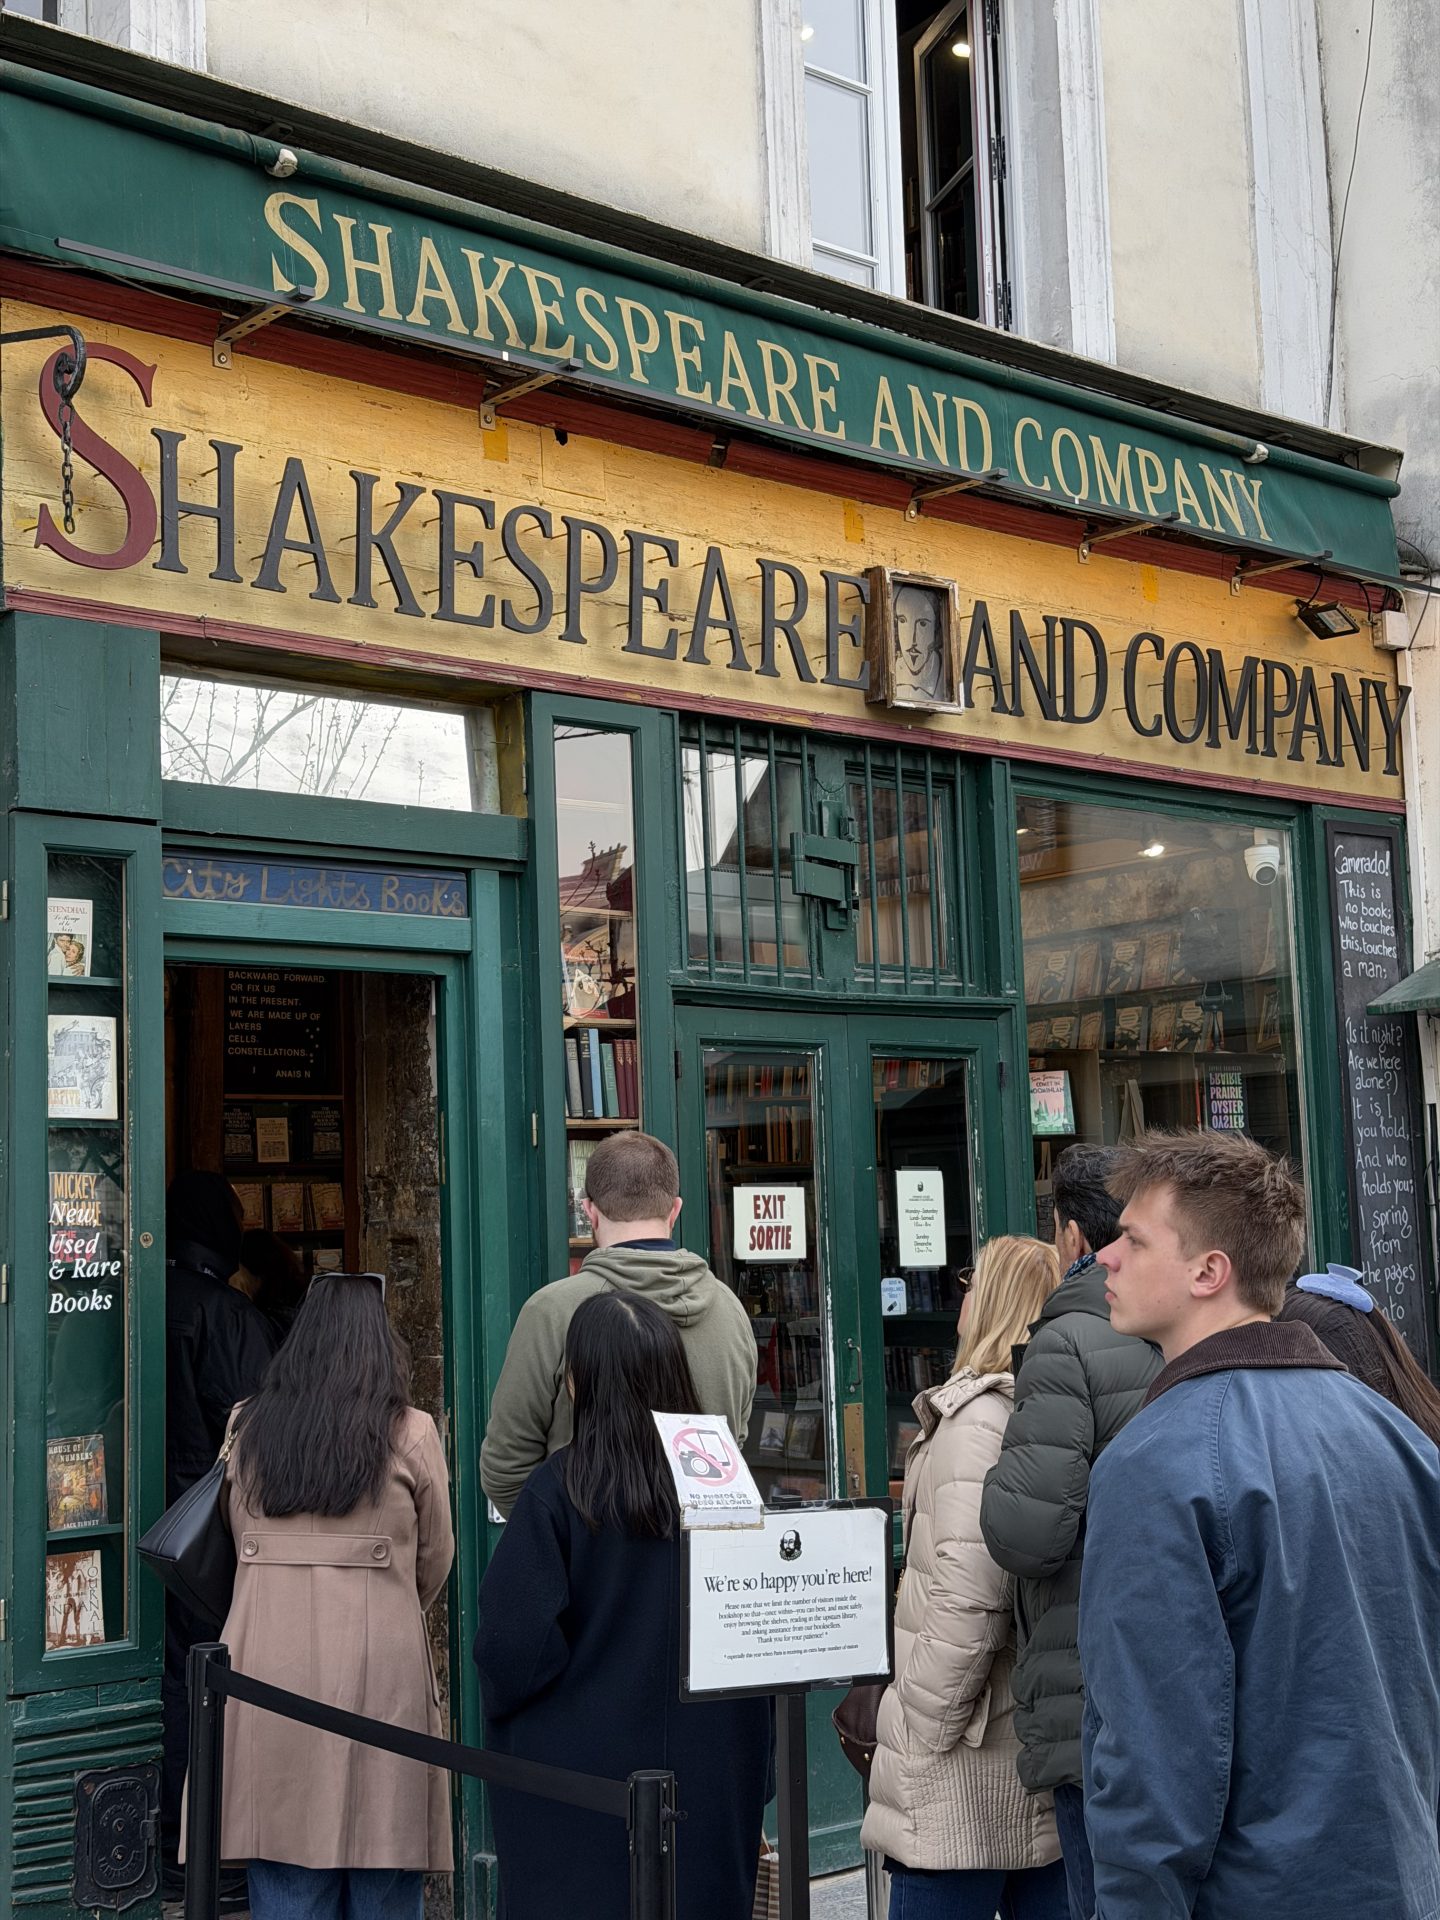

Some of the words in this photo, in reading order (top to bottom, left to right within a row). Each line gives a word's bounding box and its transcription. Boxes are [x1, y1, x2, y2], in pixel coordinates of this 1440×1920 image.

[263, 192, 845, 441] SHAKESPEARE
[872, 375, 994, 473] AND
[1014, 416, 1273, 542] COMPANY
[34, 342, 870, 690] SHAKESPEARE
[963, 600, 1108, 724] AND
[1124, 631, 1411, 776] COMPANY
[1334, 844, 1390, 877] Camerado!
[162, 858, 251, 900] City
[260, 866, 371, 911] Lights
[380, 875, 466, 916] Books
[1339, 880, 1366, 899] This
[1371, 882, 1381, 899] is
[48, 905, 88, 914] STENDHAL
[1345, 902, 1358, 914] no
[1361, 901, 1392, 920] book;
[1338, 915, 1358, 931] Who
[1360, 916, 1395, 937] touches
[1362, 937, 1397, 959] touches
[1343, 960, 1353, 979] a
[1358, 961, 1387, 979] man;
[228, 995, 238, 1004] IN
[240, 996, 257, 1005] THE
[260, 996, 301, 1006] PRESENT.
[230, 983, 243, 992] OR
[247, 984, 260, 992] FIX
[264, 985, 276, 993] US
[229, 1022, 262, 1031] LAYERS
[230, 1009, 243, 1018] WE
[248, 1010, 264, 1019] ARE
[269, 1011, 292, 1020] MADE
[295, 1012, 307, 1020] UP
[310, 1012, 321, 1021] OF
[1360, 1018, 1369, 1043] it
[1371, 1022, 1403, 1053] night?
[1348, 1049, 1365, 1071] Are
[1365, 1055, 1379, 1070] we
[1379, 1051, 1401, 1071] here
[1210, 1086, 1243, 1099] PRAIRIE
[1355, 1071, 1398, 1096] alone?)
[1211, 1100, 1244, 1114] OYSTER
[1352, 1096, 1362, 1120] It
[1369, 1097, 1382, 1117] is
[1356, 1125, 1378, 1147] you
[1379, 1115, 1409, 1141] hold,
[1355, 1144, 1381, 1170] And
[1386, 1144, 1407, 1167] who
[54, 1173, 97, 1199] MICKEY
[1361, 1170, 1391, 1197] holds
[1392, 1178, 1414, 1204] you;
[48, 1202, 98, 1228] New,
[753, 1194, 786, 1220] EXIT
[1372, 1205, 1412, 1239] spring
[49, 1232, 100, 1255] Used
[749, 1225, 792, 1251] SORTIE
[1369, 1230, 1401, 1262] from
[49, 1259, 66, 1280] &
[71, 1257, 121, 1279] Rare
[1361, 1260, 1382, 1286] the
[1384, 1262, 1416, 1295] pages
[48, 1289, 113, 1314] Books
[1380, 1295, 1405, 1322] nto
[60, 1451, 93, 1462] NUMBERS
[742, 1577, 758, 1591] so
[760, 1572, 800, 1594] happy
[842, 1565, 872, 1584] here!
